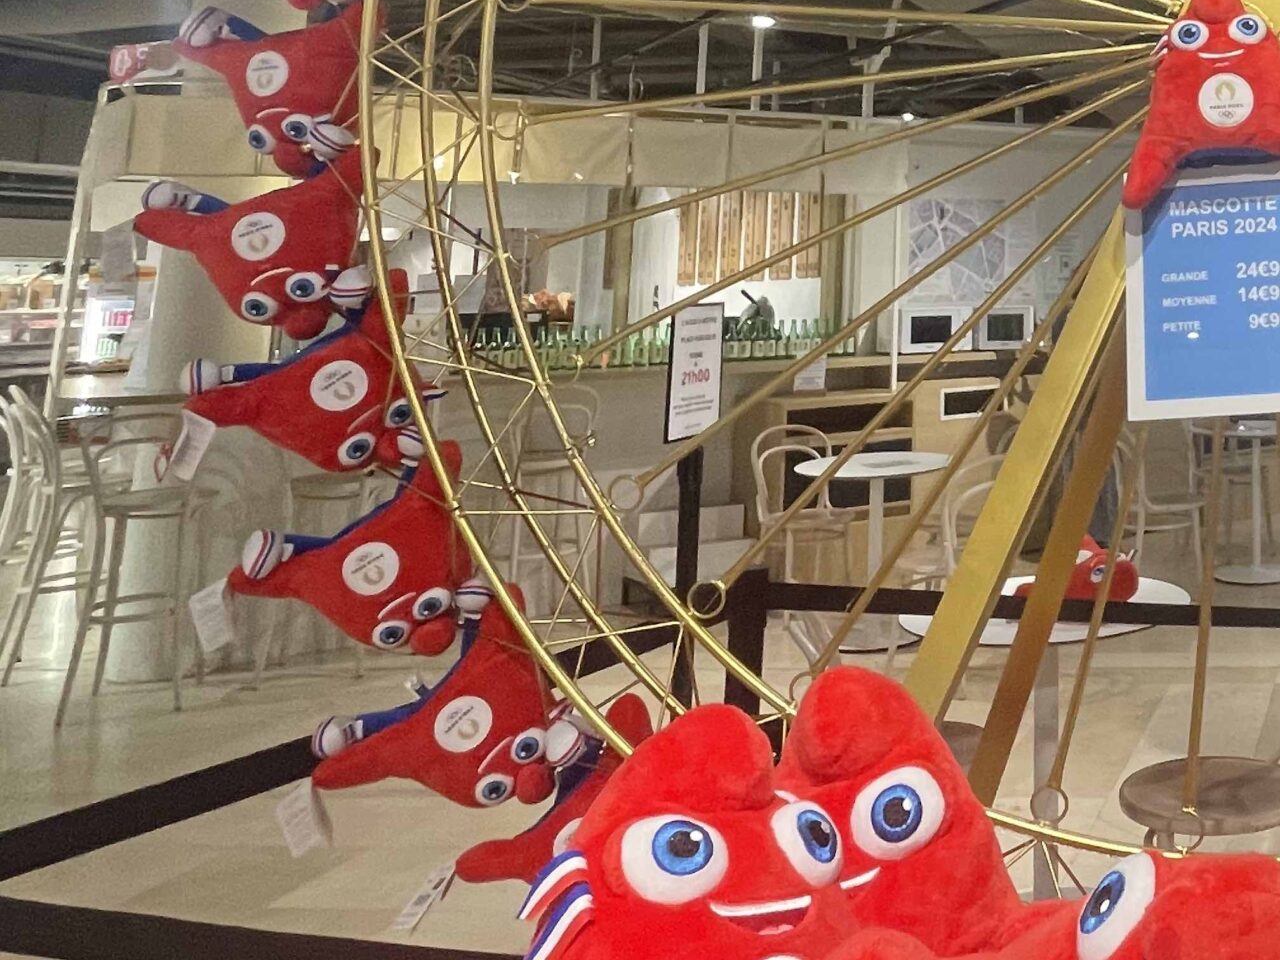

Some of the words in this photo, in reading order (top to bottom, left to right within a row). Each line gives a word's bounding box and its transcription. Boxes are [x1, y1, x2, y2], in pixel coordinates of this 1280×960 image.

[1169, 195, 1278, 217] MASCOTTE
[1171, 219, 1229, 239] PARIS
[1234, 217, 1278, 235] 2024
[1161, 270, 1209, 283] GRANDE
[1162, 294, 1217, 308] MOYENNE
[1162, 320, 1202, 333] PETITE
[681, 368, 710, 386] 21h00
